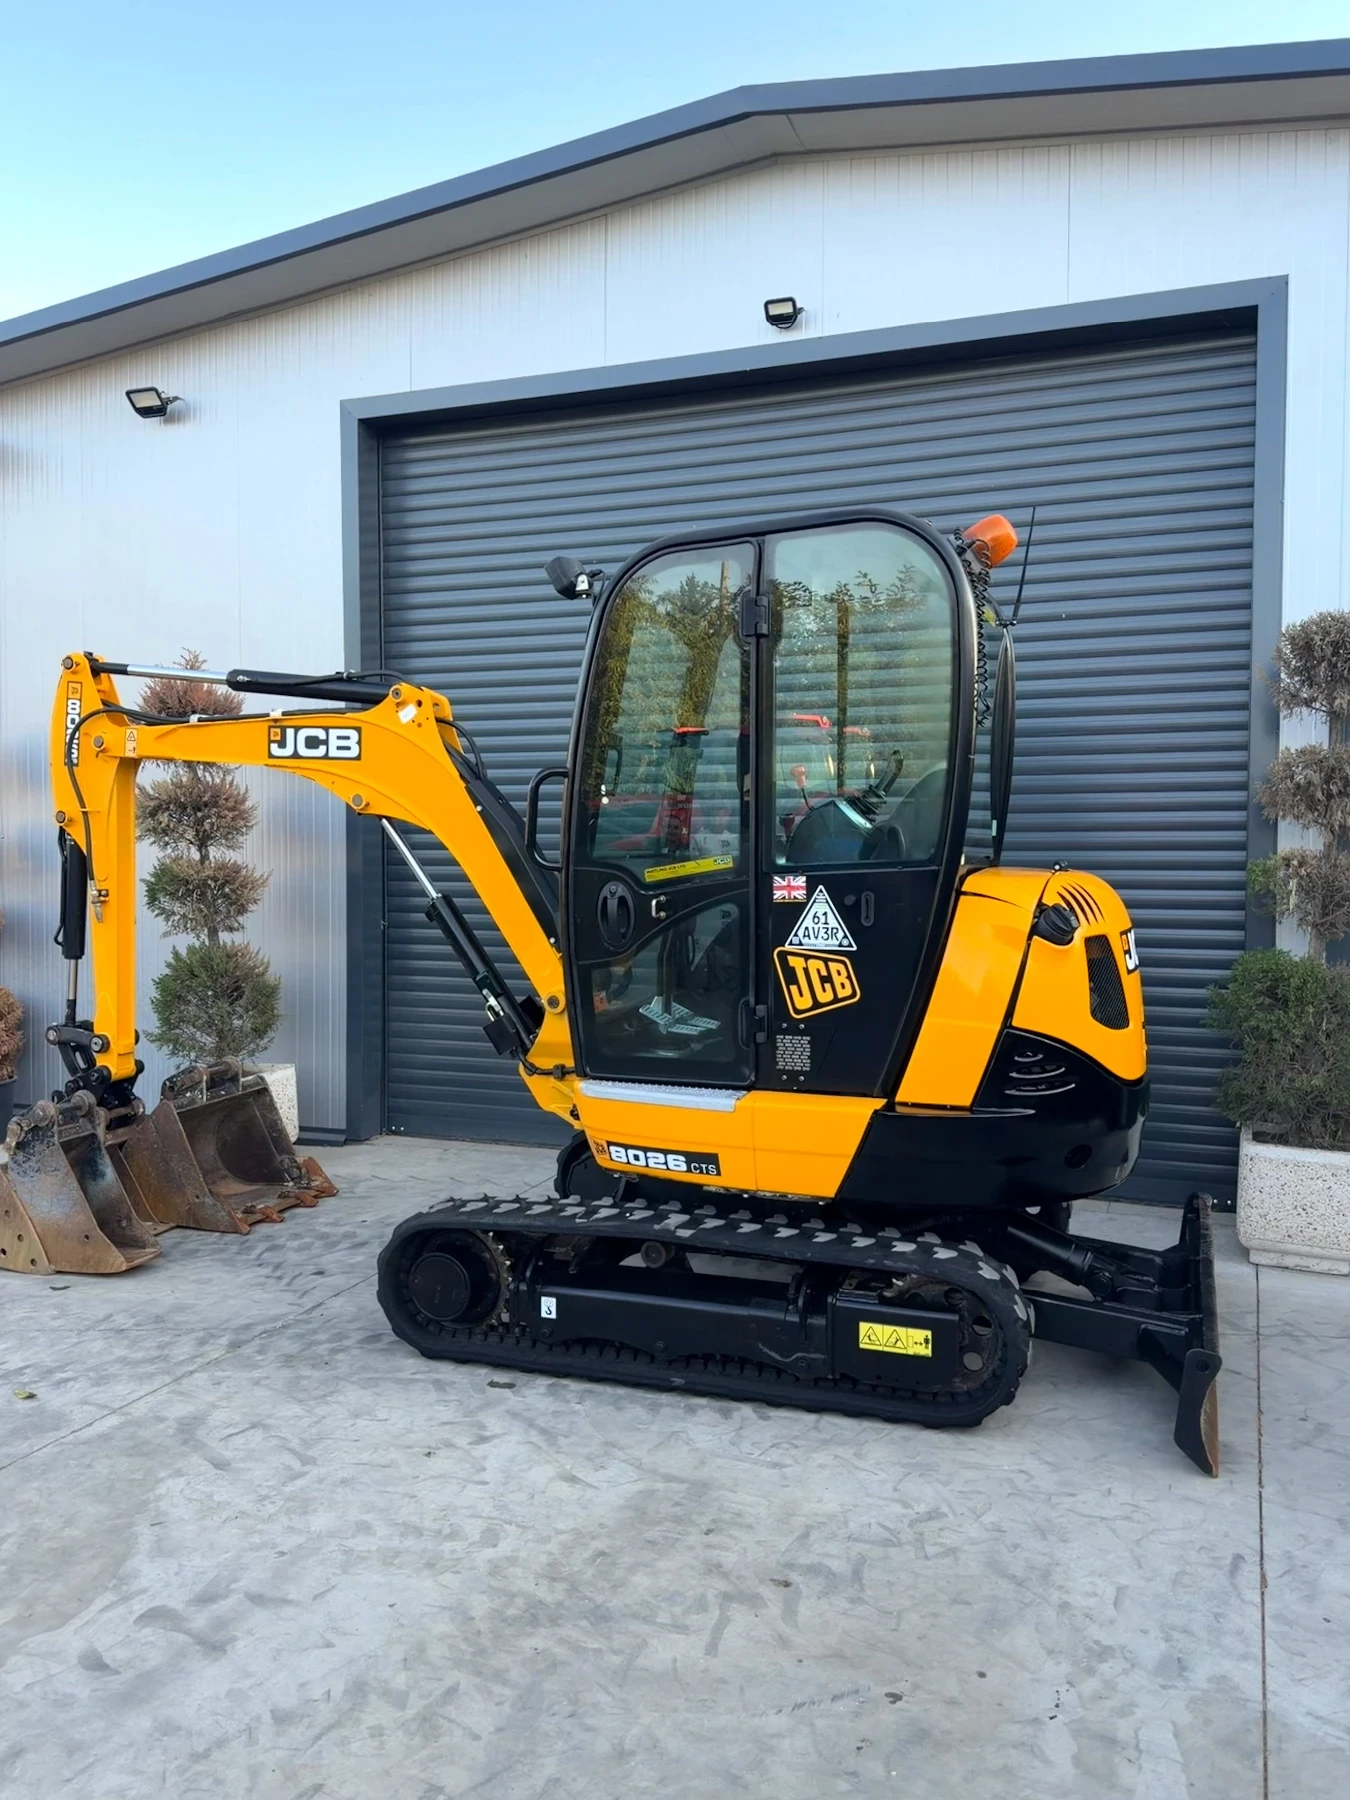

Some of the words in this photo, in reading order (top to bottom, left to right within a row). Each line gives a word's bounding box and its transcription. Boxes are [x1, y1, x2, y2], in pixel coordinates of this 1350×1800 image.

[269, 727, 361, 759] JCB
[713, 857, 731, 866] JCB
[812, 911, 830, 926] 61
[802, 926, 840, 942] AV3R
[786, 954, 854, 1011] JCB
[609, 1145, 688, 1172] 8026
[690, 1162, 718, 1176] CTS
